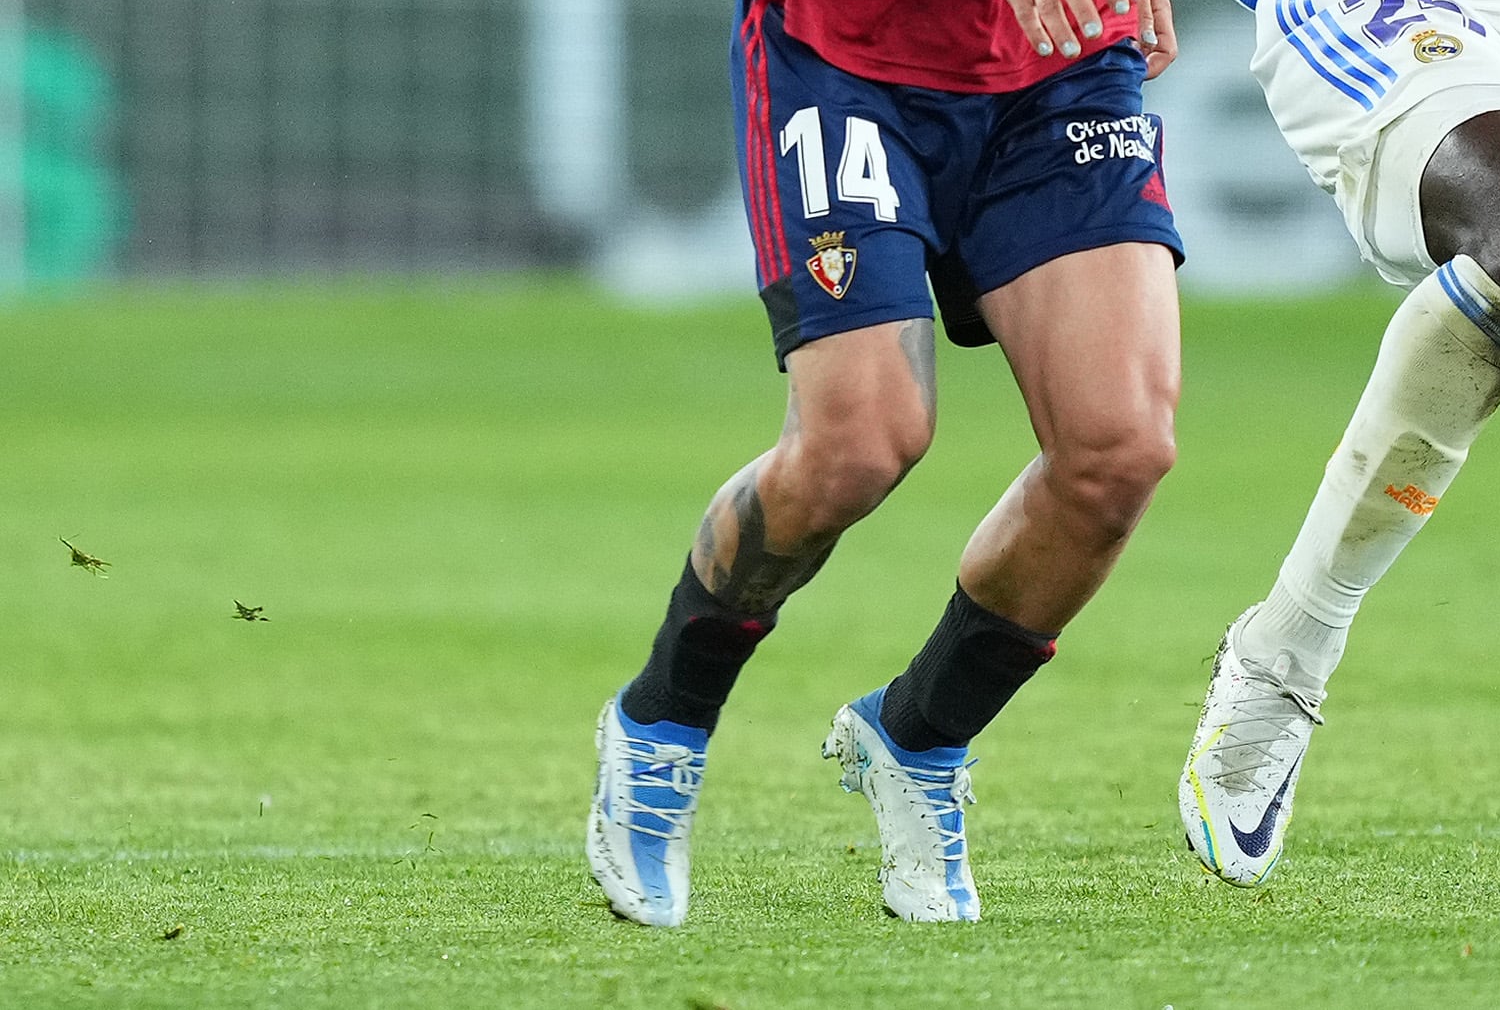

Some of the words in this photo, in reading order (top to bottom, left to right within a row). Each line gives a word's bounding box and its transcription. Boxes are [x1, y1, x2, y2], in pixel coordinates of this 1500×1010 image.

[1074, 142, 1104, 164] de
[780, 106, 900, 223] 14
[1403, 484, 1438, 505] REA
